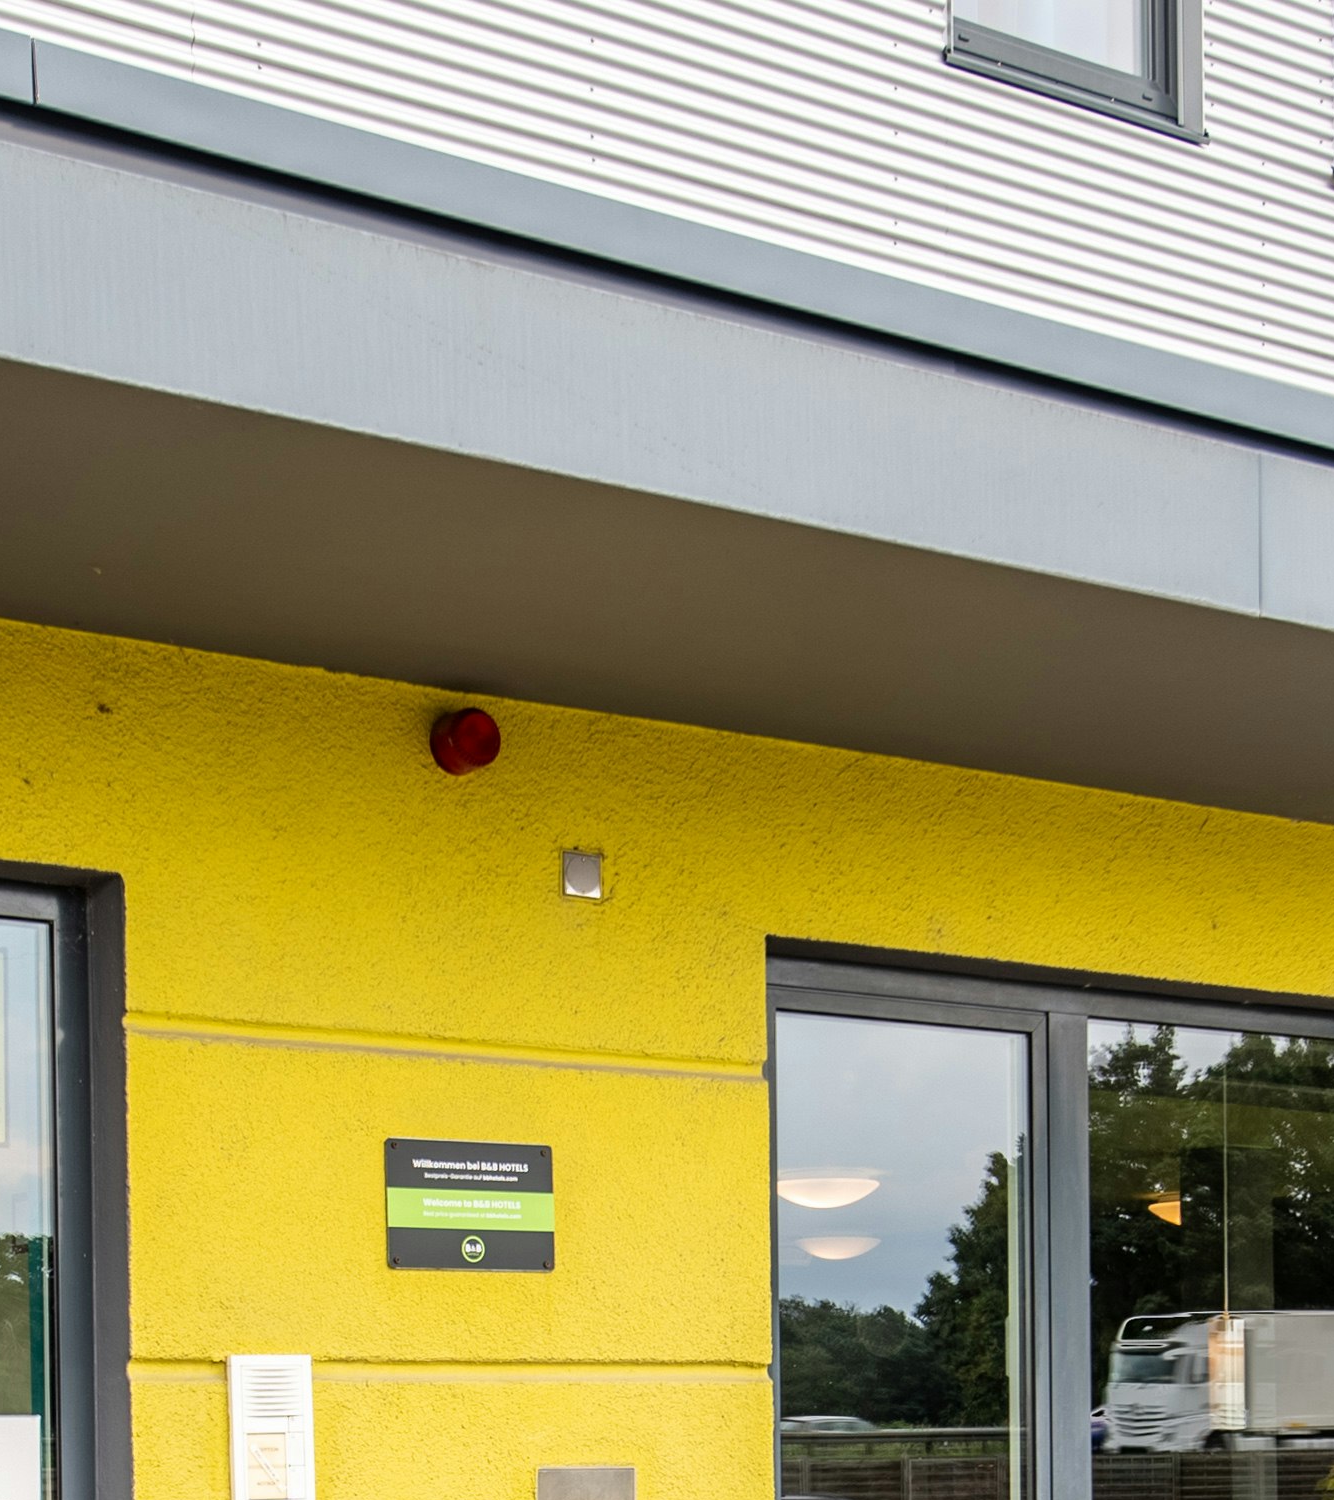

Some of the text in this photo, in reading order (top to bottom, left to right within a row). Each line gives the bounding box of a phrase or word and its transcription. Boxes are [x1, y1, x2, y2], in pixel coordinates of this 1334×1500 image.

[412, 1158, 529, 1173] Willkommen bei B&B HOTELS
[422, 1198, 521, 1210] Welcome to B&B HOTELS
